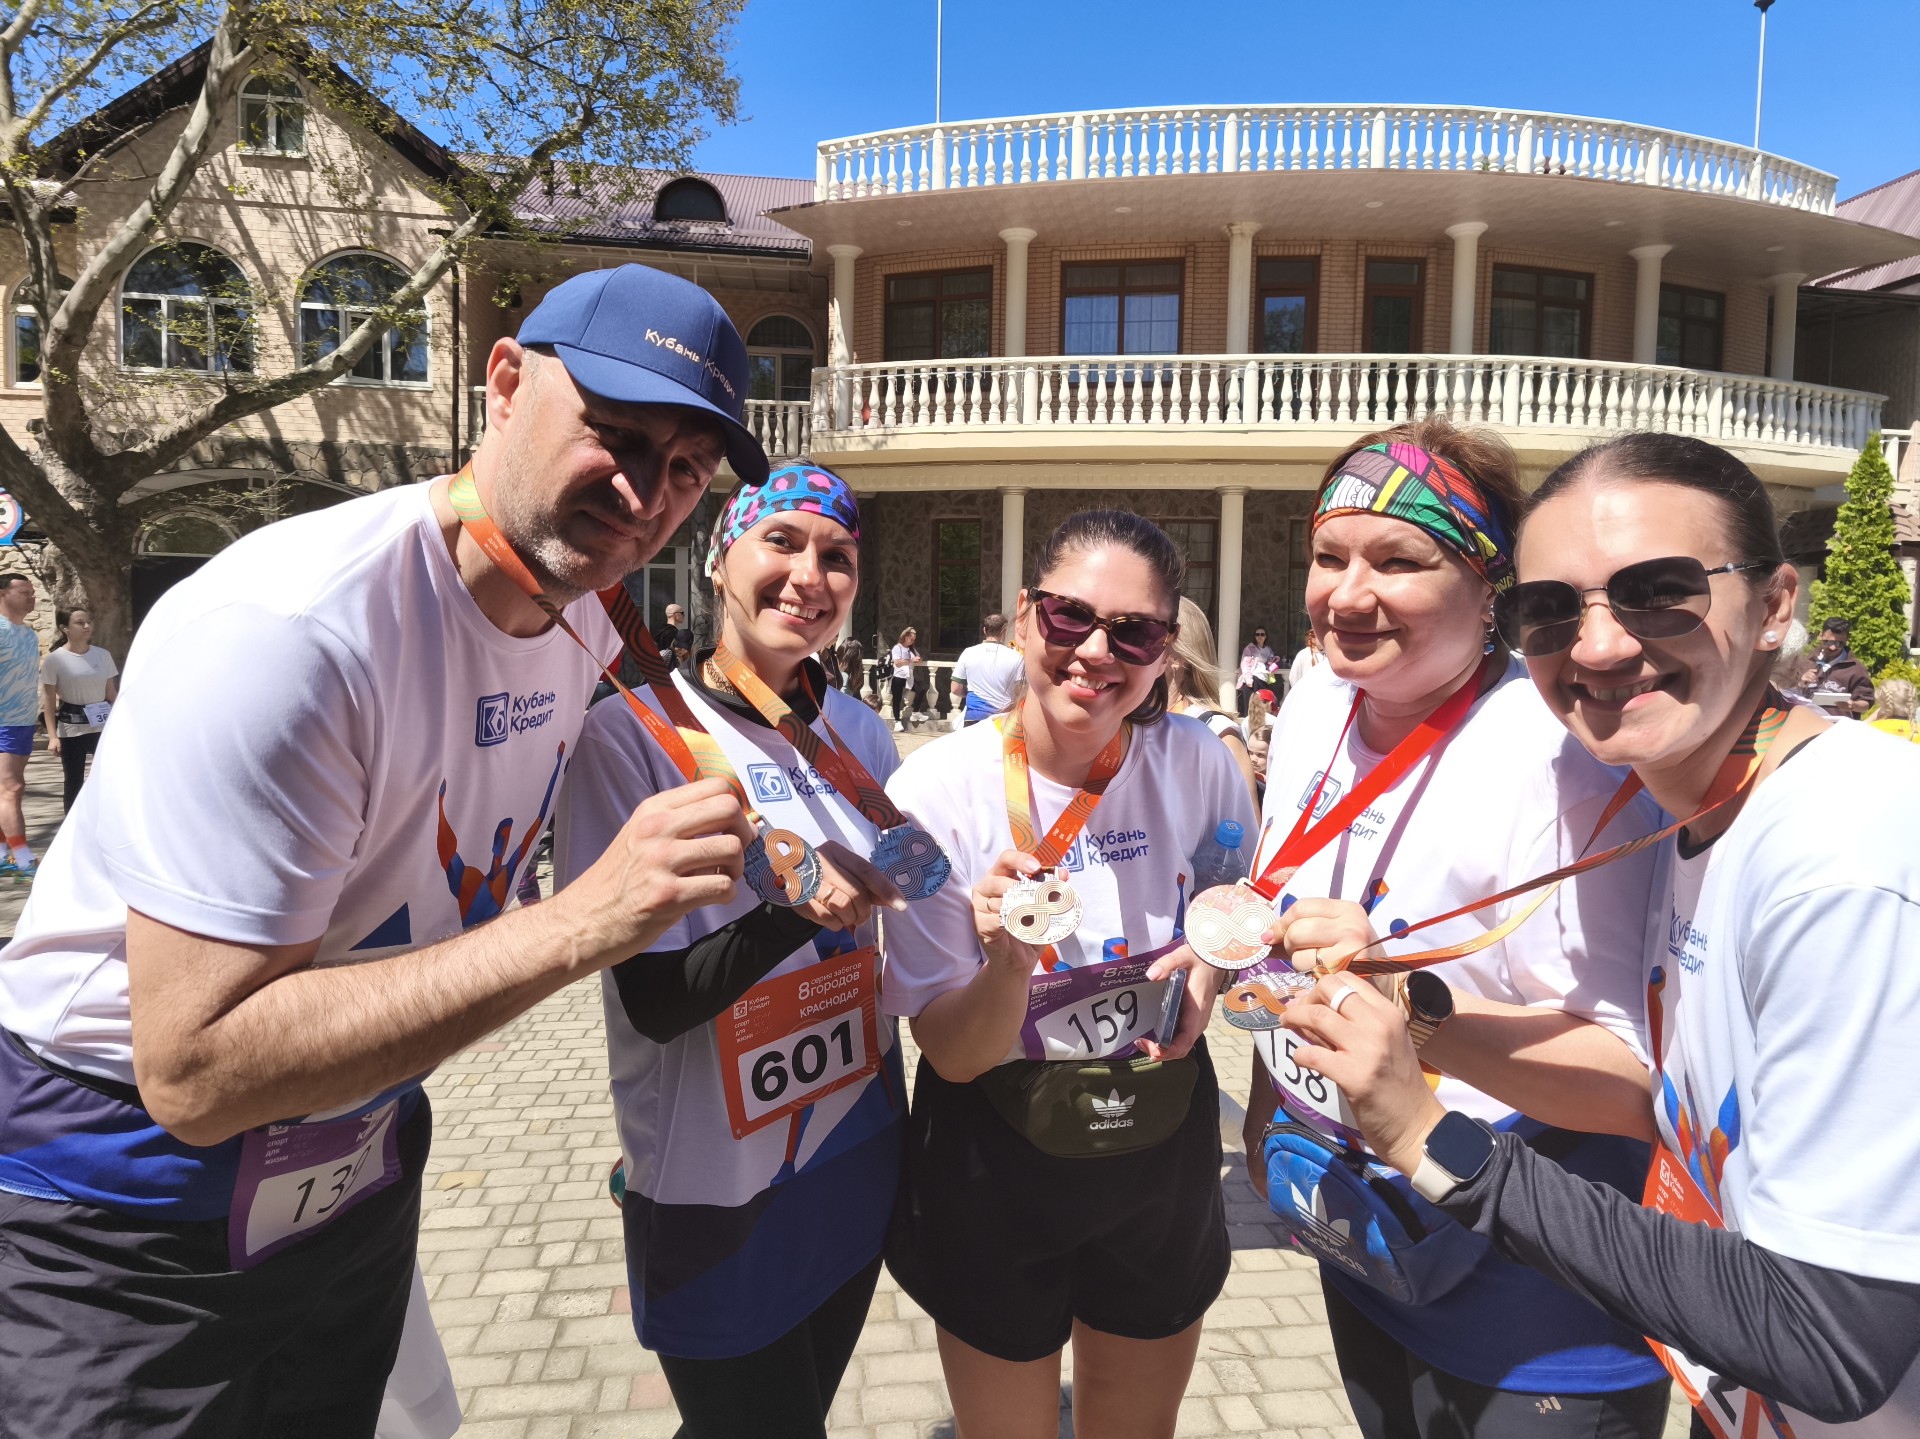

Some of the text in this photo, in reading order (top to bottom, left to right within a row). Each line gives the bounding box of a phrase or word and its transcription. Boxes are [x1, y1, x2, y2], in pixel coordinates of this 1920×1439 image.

[645, 328, 736, 400] Кубань Кредит
[512, 691, 556, 715] Кубань
[510, 709, 554, 735] Кредит
[788, 765, 826, 784] Куб
[793, 782, 838, 798] Кред
[1085, 829, 1147, 850] Кубань
[1346, 821, 1378, 841] дит
[1087, 845, 1149, 867] Кредит
[1117, 965, 1150, 977] горо
[1210, 951, 1267, 970] КРАСНОДАР
[810, 962, 862, 985] серия забегов
[1100, 973, 1149, 988] КРАСНО
[800, 988, 859, 1018] КРАСНОДАР
[1067, 989, 1139, 1055] 159
[751, 1019, 854, 1102] 601
[1270, 1029, 1328, 1104] 158
[1090, 1118, 1134, 1130] adidas
[265, 1148, 280, 1158] для
[267, 1137, 289, 1148] спорт
[1301, 1229, 1368, 1277] adidas
